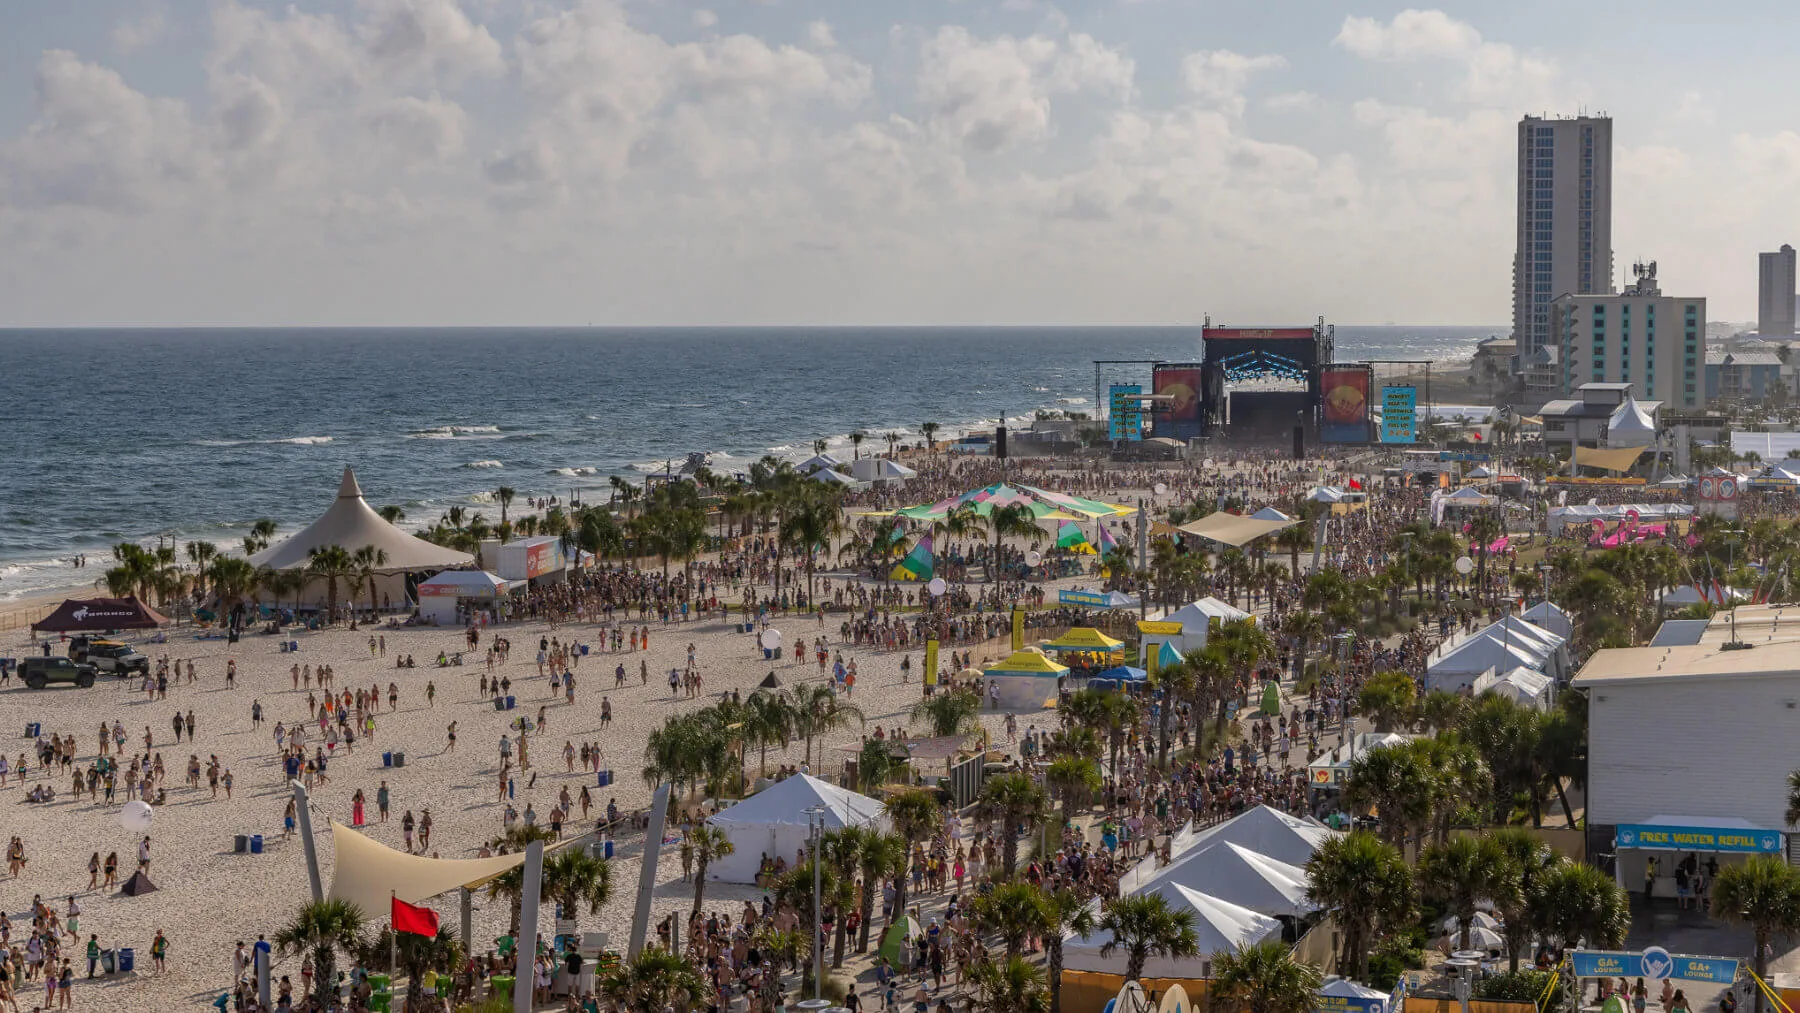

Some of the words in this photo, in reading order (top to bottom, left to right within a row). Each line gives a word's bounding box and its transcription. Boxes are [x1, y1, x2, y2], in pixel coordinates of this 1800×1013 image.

[1639, 831, 1668, 843] FREE
[1672, 832, 1715, 845] WATER
[1718, 835, 1756, 847] REFILL
[1597, 958, 1619, 967] GA+
[1688, 961, 1711, 971] GA+
[1684, 970, 1713, 979] LOUNGE
